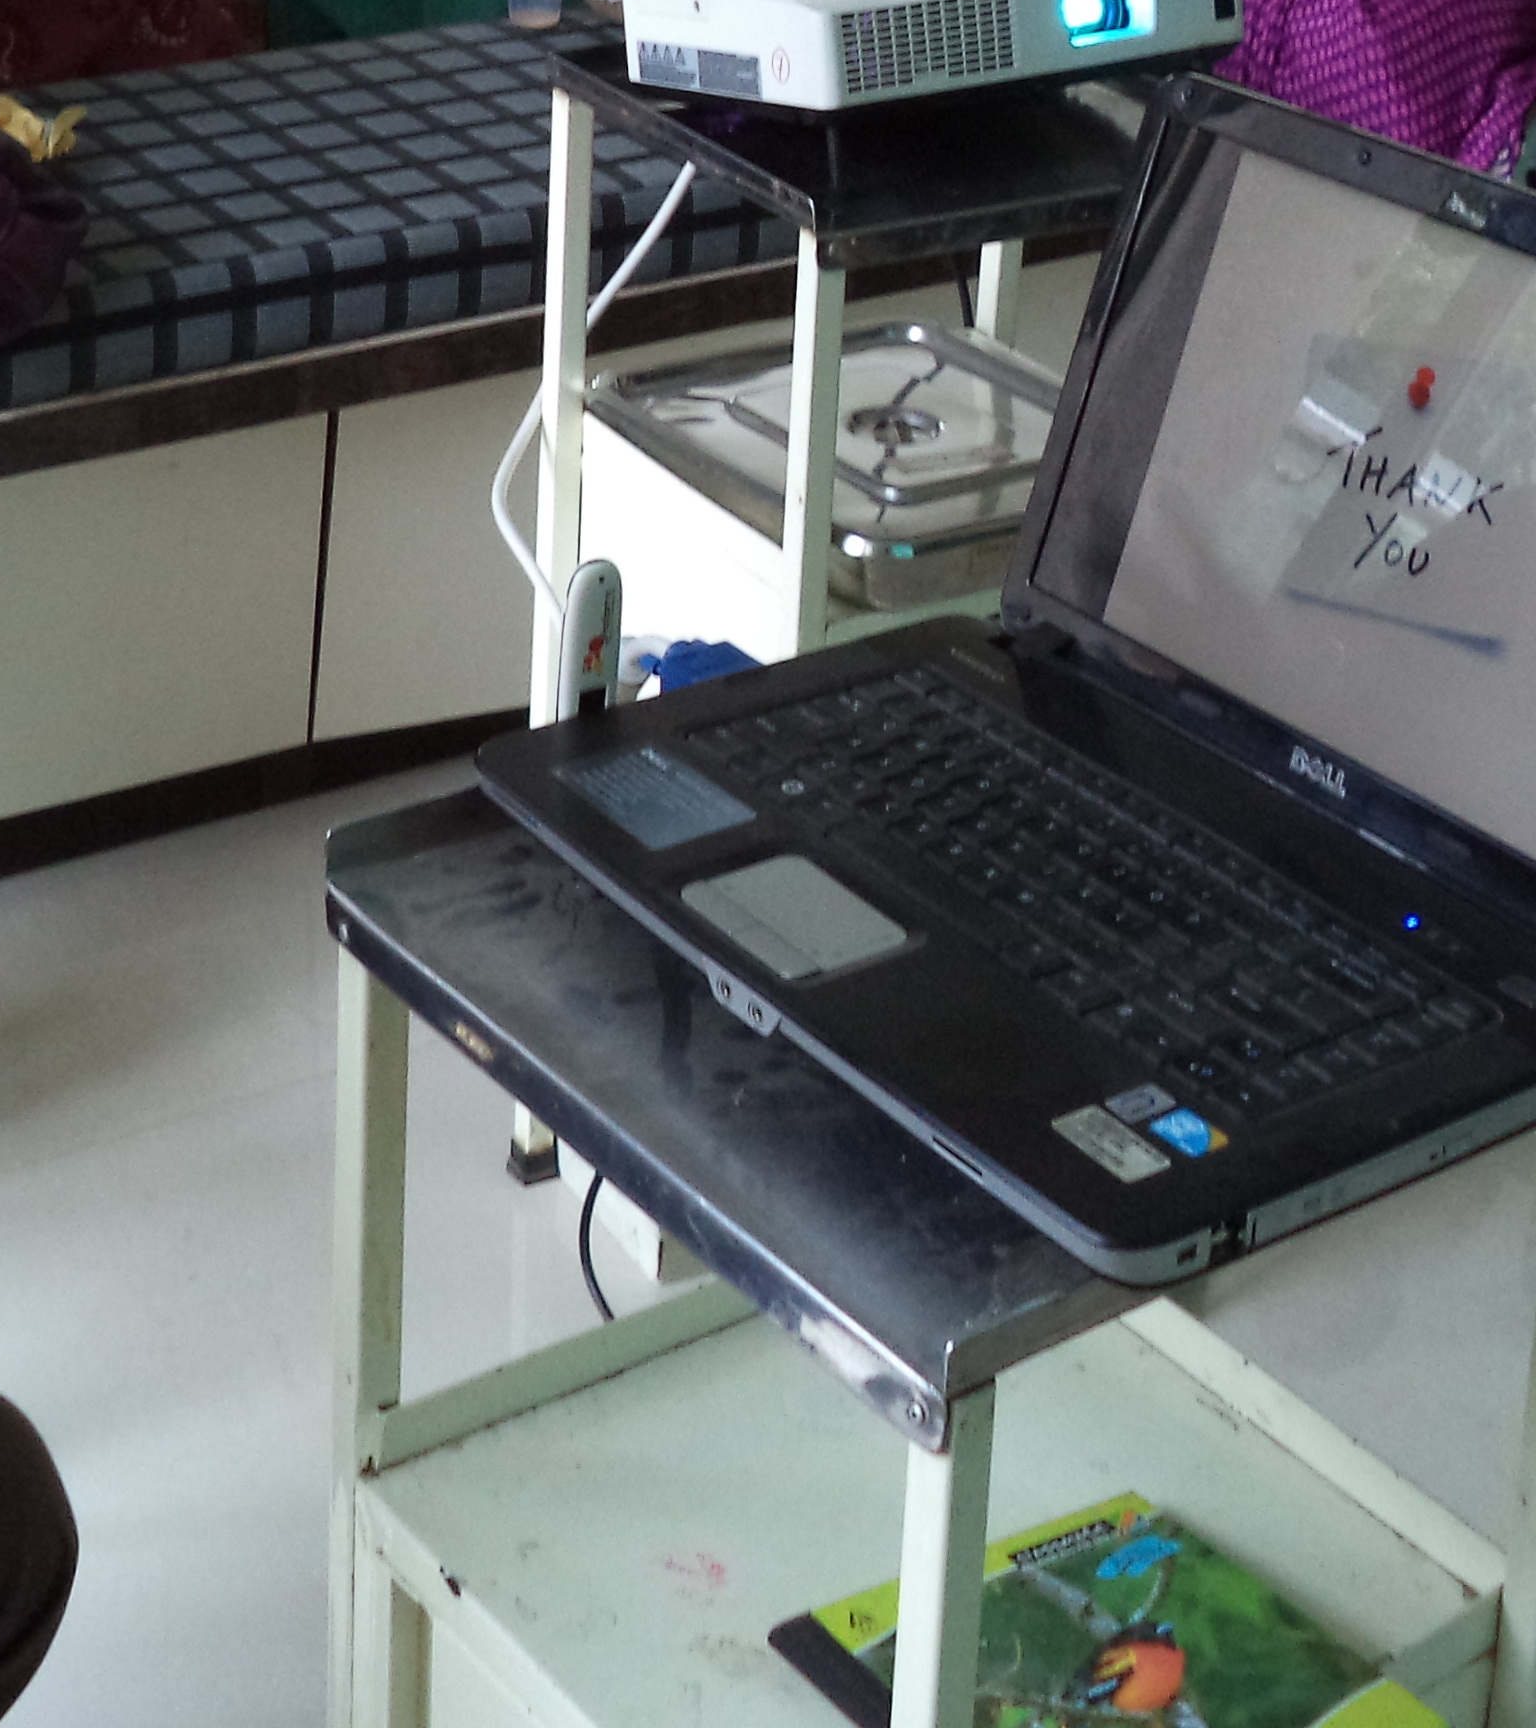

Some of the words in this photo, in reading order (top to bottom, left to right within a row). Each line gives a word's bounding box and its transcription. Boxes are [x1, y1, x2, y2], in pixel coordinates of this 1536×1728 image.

[1327, 426, 1505, 525] THANK
[1354, 512, 1430, 575] YOU
[1289, 745, 1345, 799] DELL
